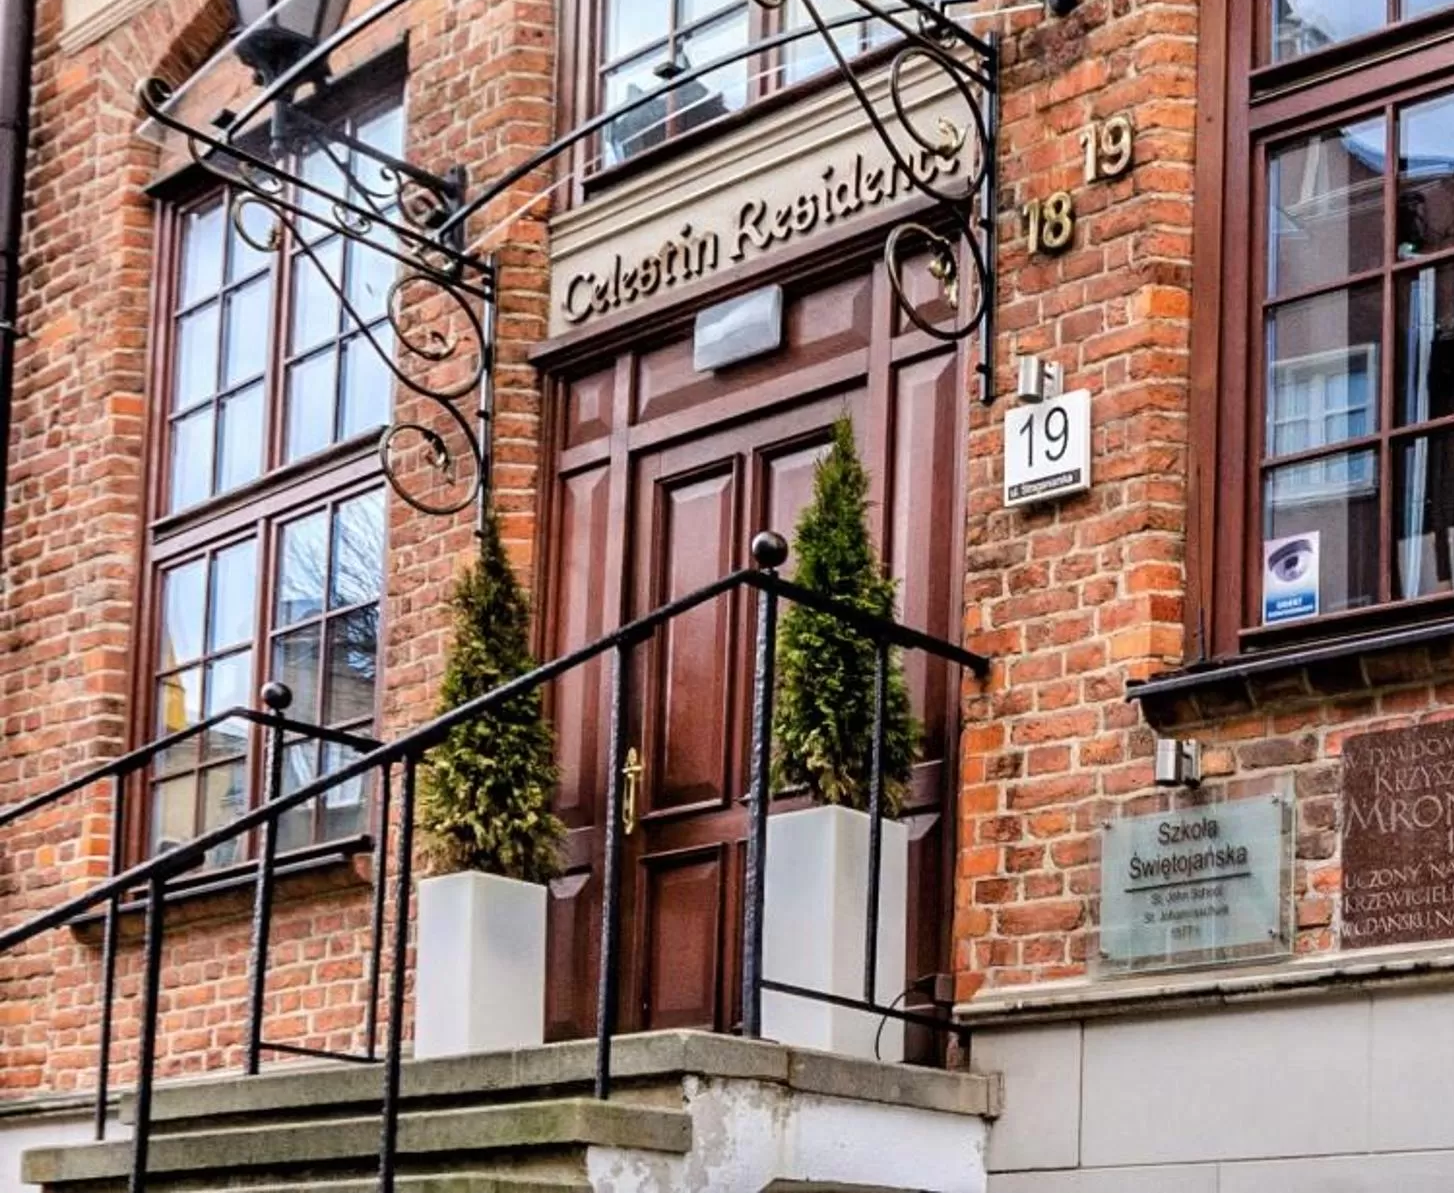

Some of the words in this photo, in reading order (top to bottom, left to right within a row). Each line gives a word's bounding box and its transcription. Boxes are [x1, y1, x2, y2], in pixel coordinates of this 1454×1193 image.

[1079, 115, 1133, 183] 19
[1022, 190, 1073, 254] 18
[562, 222, 719, 325] Celestin
[1019, 405, 1069, 468] 19
